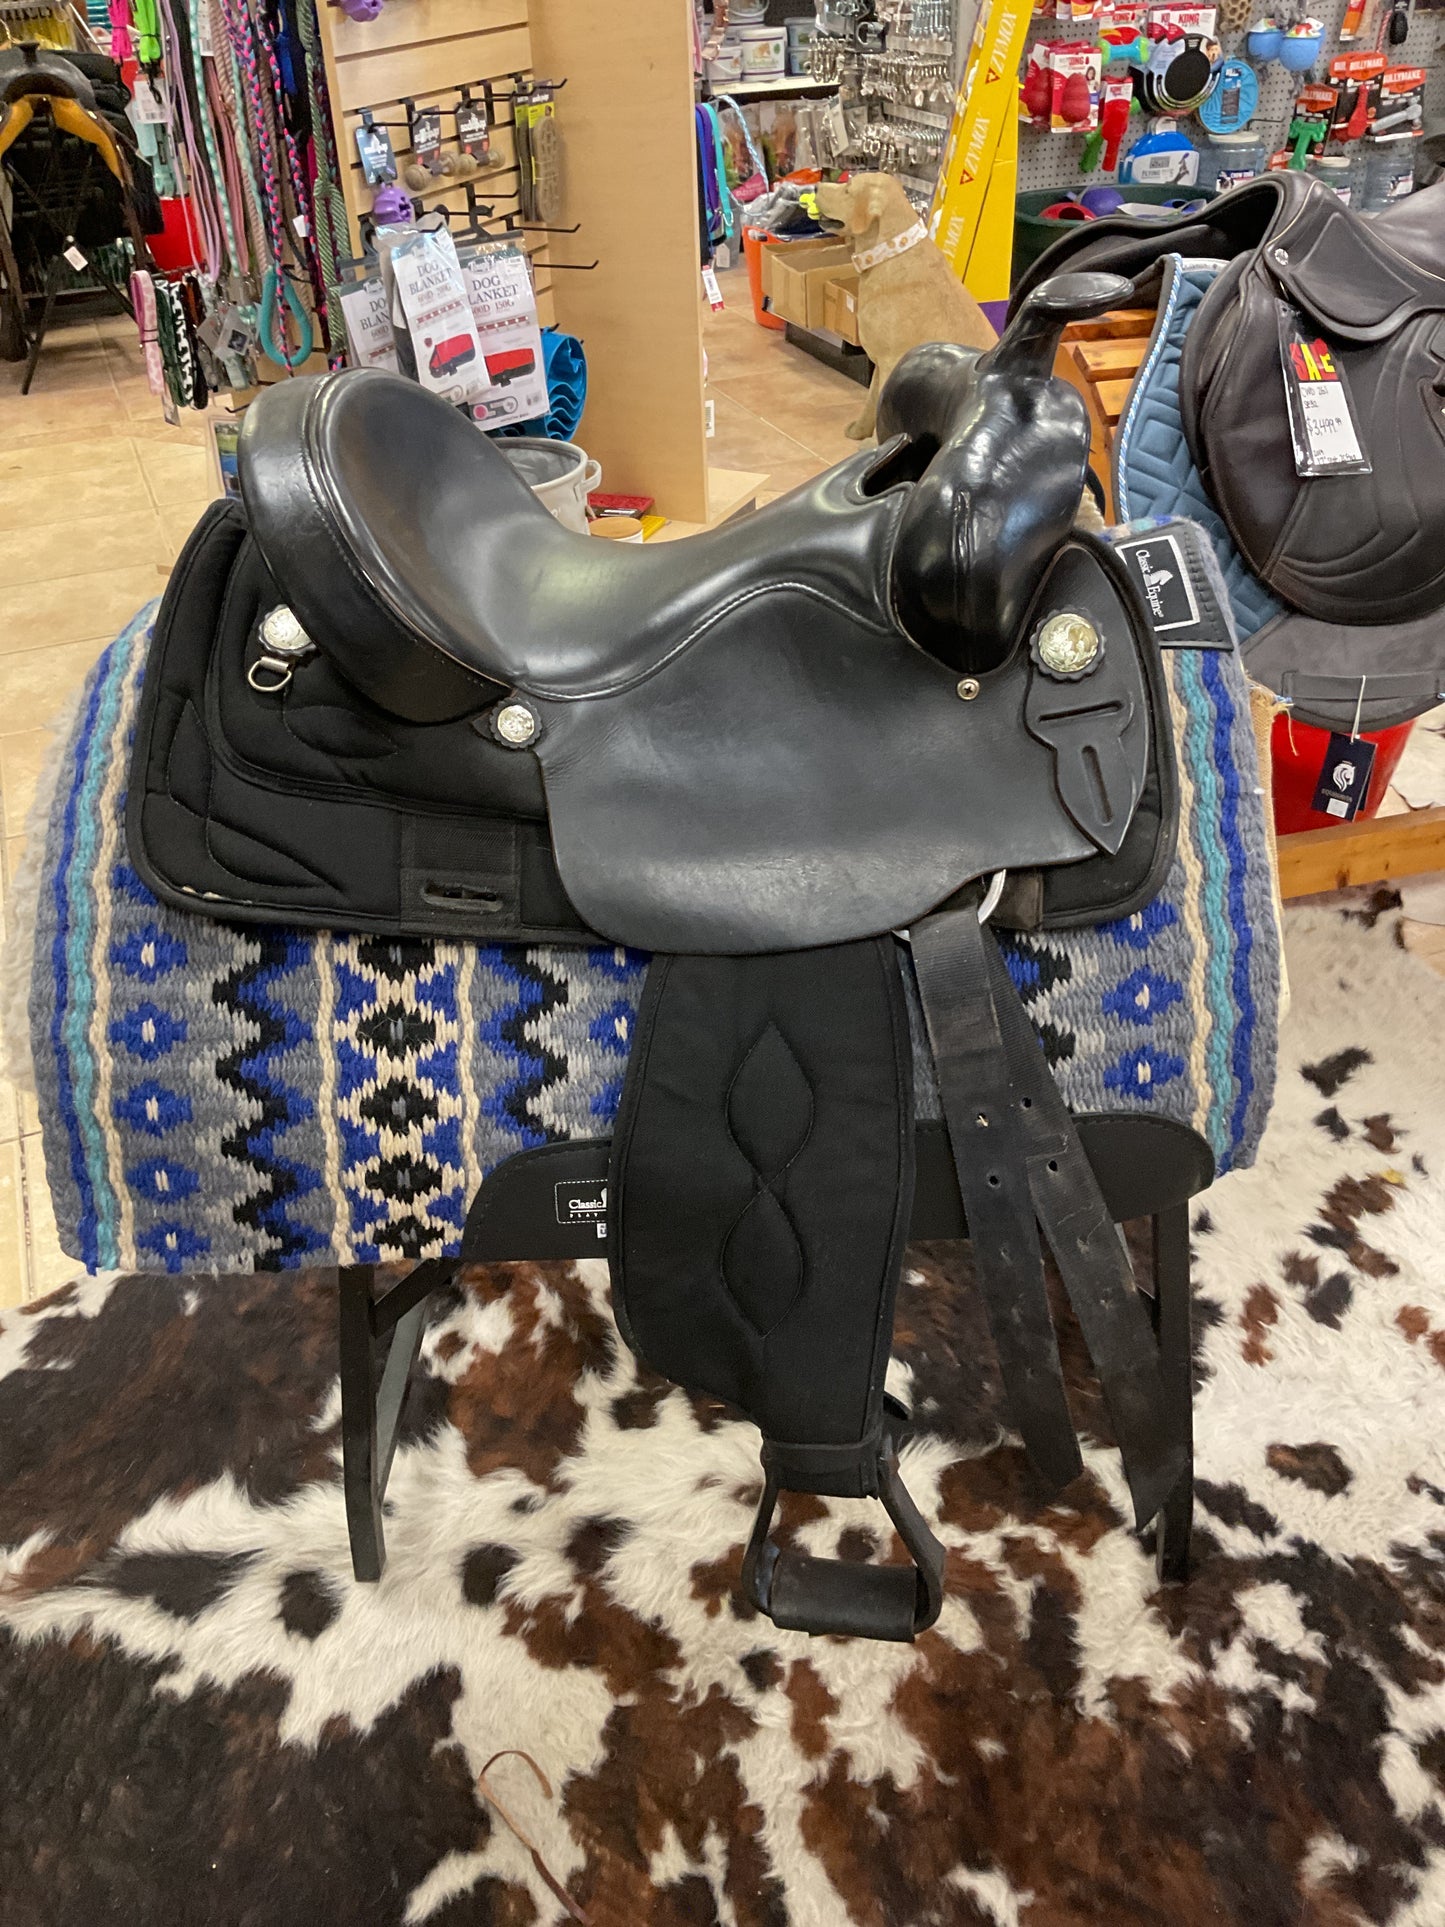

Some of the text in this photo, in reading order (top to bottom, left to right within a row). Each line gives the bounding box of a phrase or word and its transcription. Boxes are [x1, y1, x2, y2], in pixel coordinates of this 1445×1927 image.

[1178, 13, 1200, 24] KONG
[990, 6, 1017, 74] ZYMOX
[1349, 57, 1384, 71] BULLYMAKE
[964, 111, 990, 175] ZYMOX
[942, 206, 965, 259] YMOX
[409, 267, 453, 295] BLANKET
[472, 275, 501, 291] DOG
[369, 297, 386, 312] DO
[468, 283, 518, 306] LANKET
[1290, 338, 1338, 381] SALE
[1136, 550, 1153, 575] Classic
[568, 1199, 603, 1210] Classic
